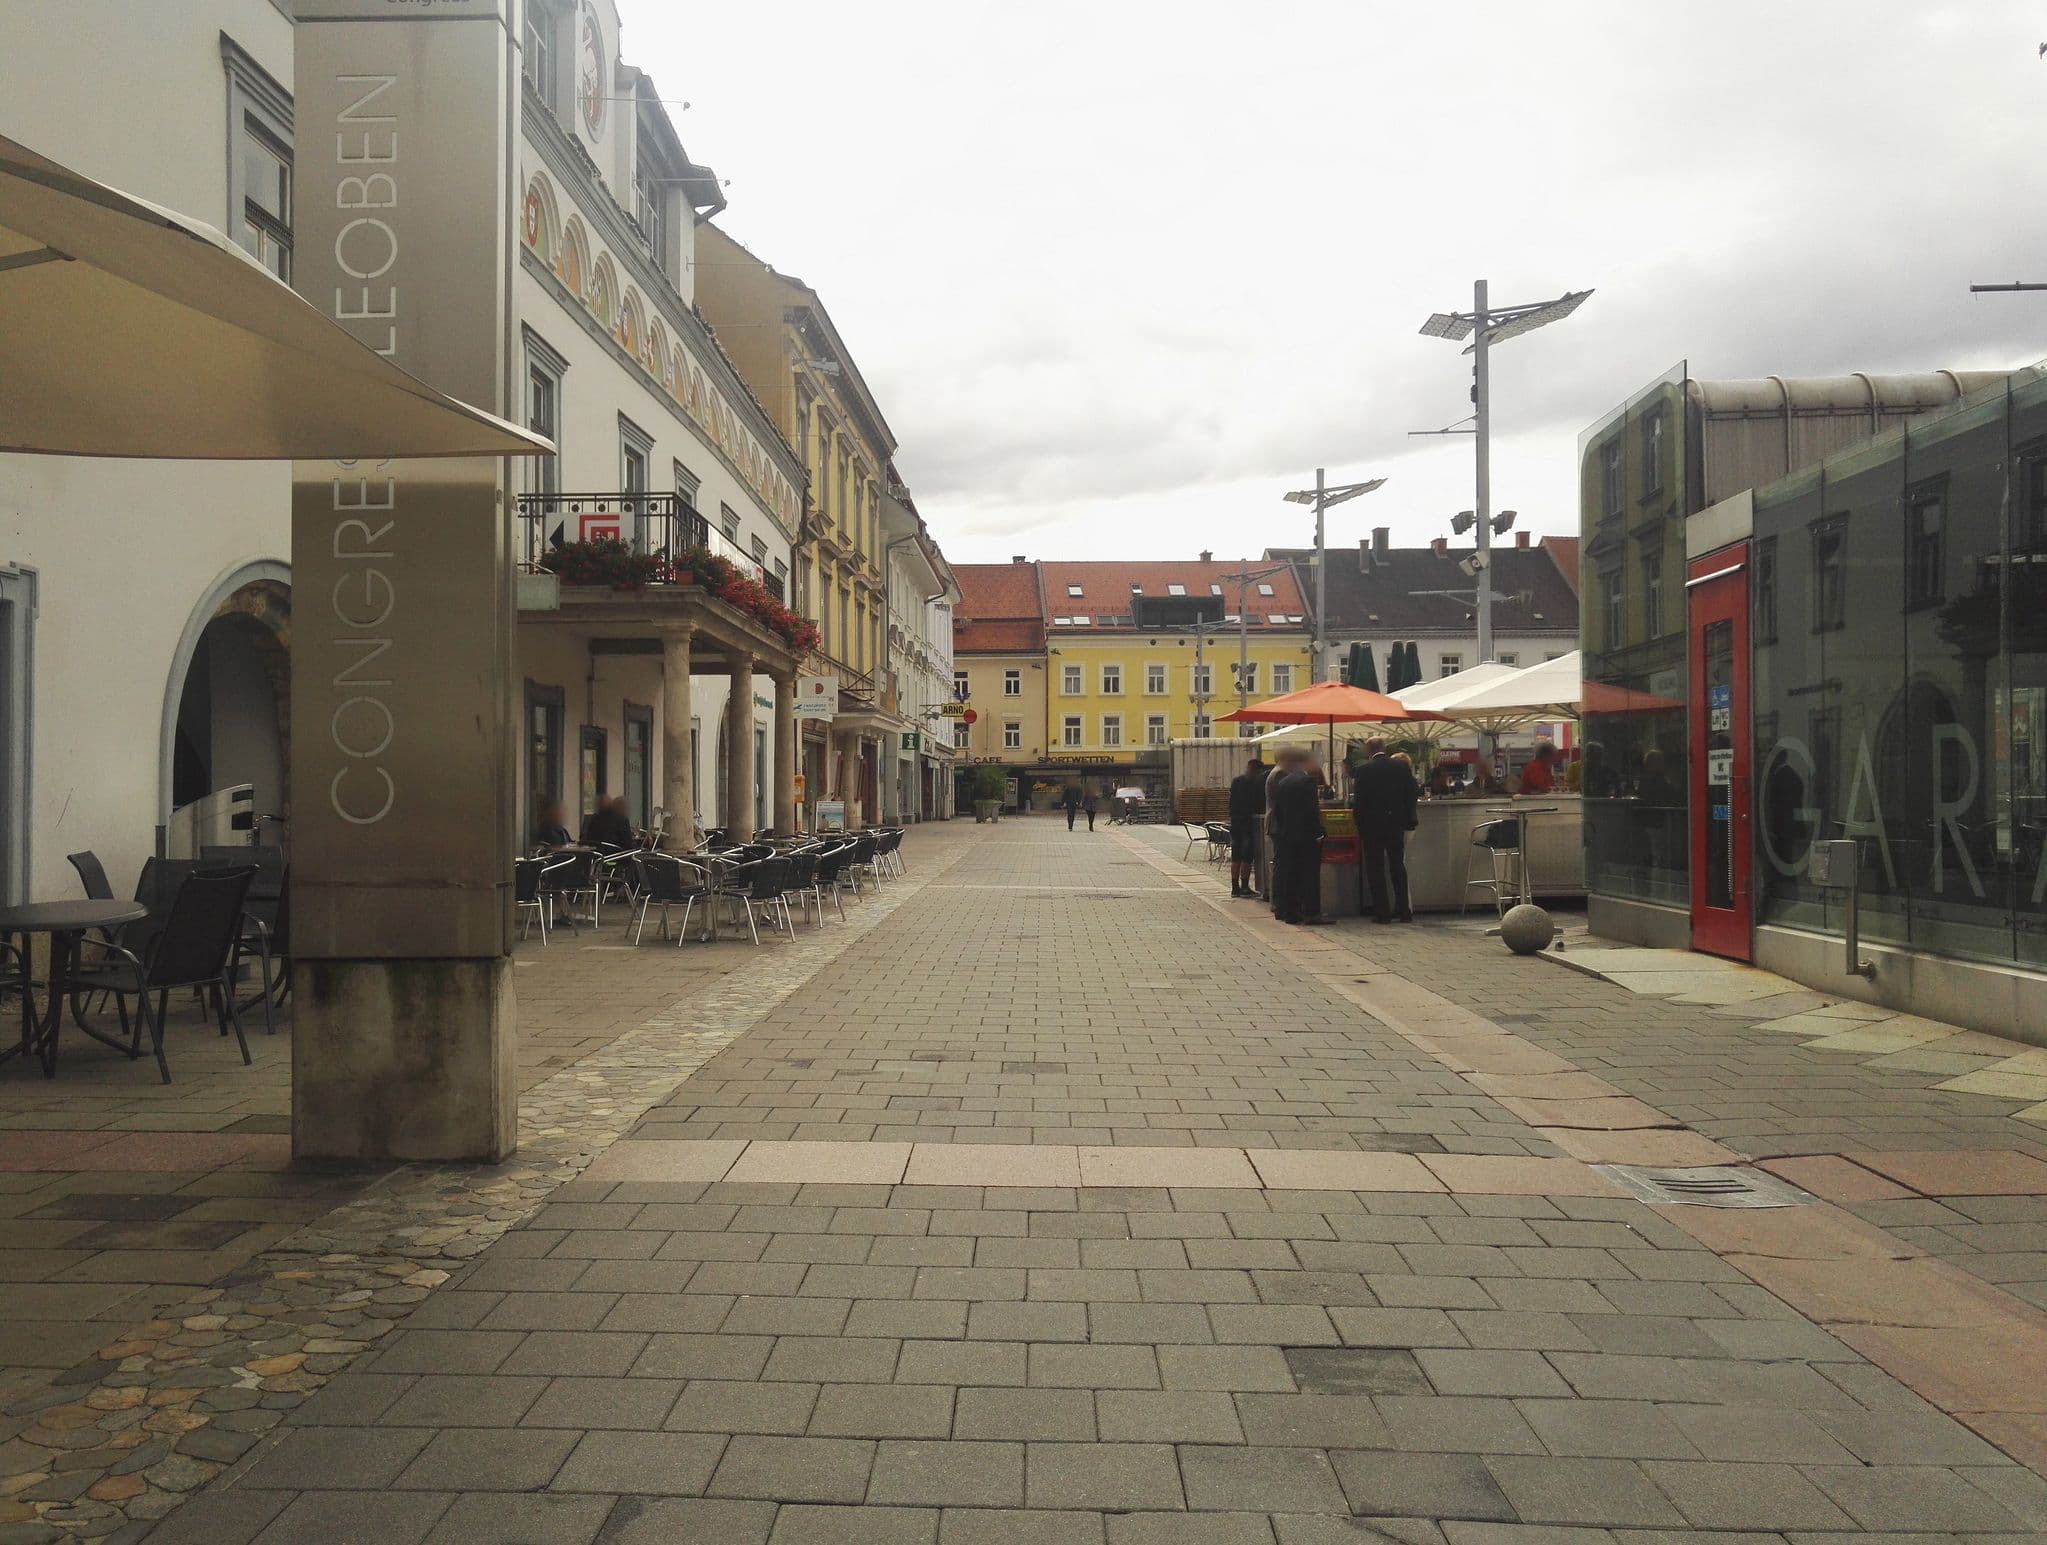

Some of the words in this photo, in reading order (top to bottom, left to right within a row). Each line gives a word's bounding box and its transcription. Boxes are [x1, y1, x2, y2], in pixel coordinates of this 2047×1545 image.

[943, 705, 964, 715] ARNO
[974, 756, 1002, 764] CAFE
[1037, 755, 1115, 764] SPORTWETTEN
[1758, 723, 2047, 904] GAR
